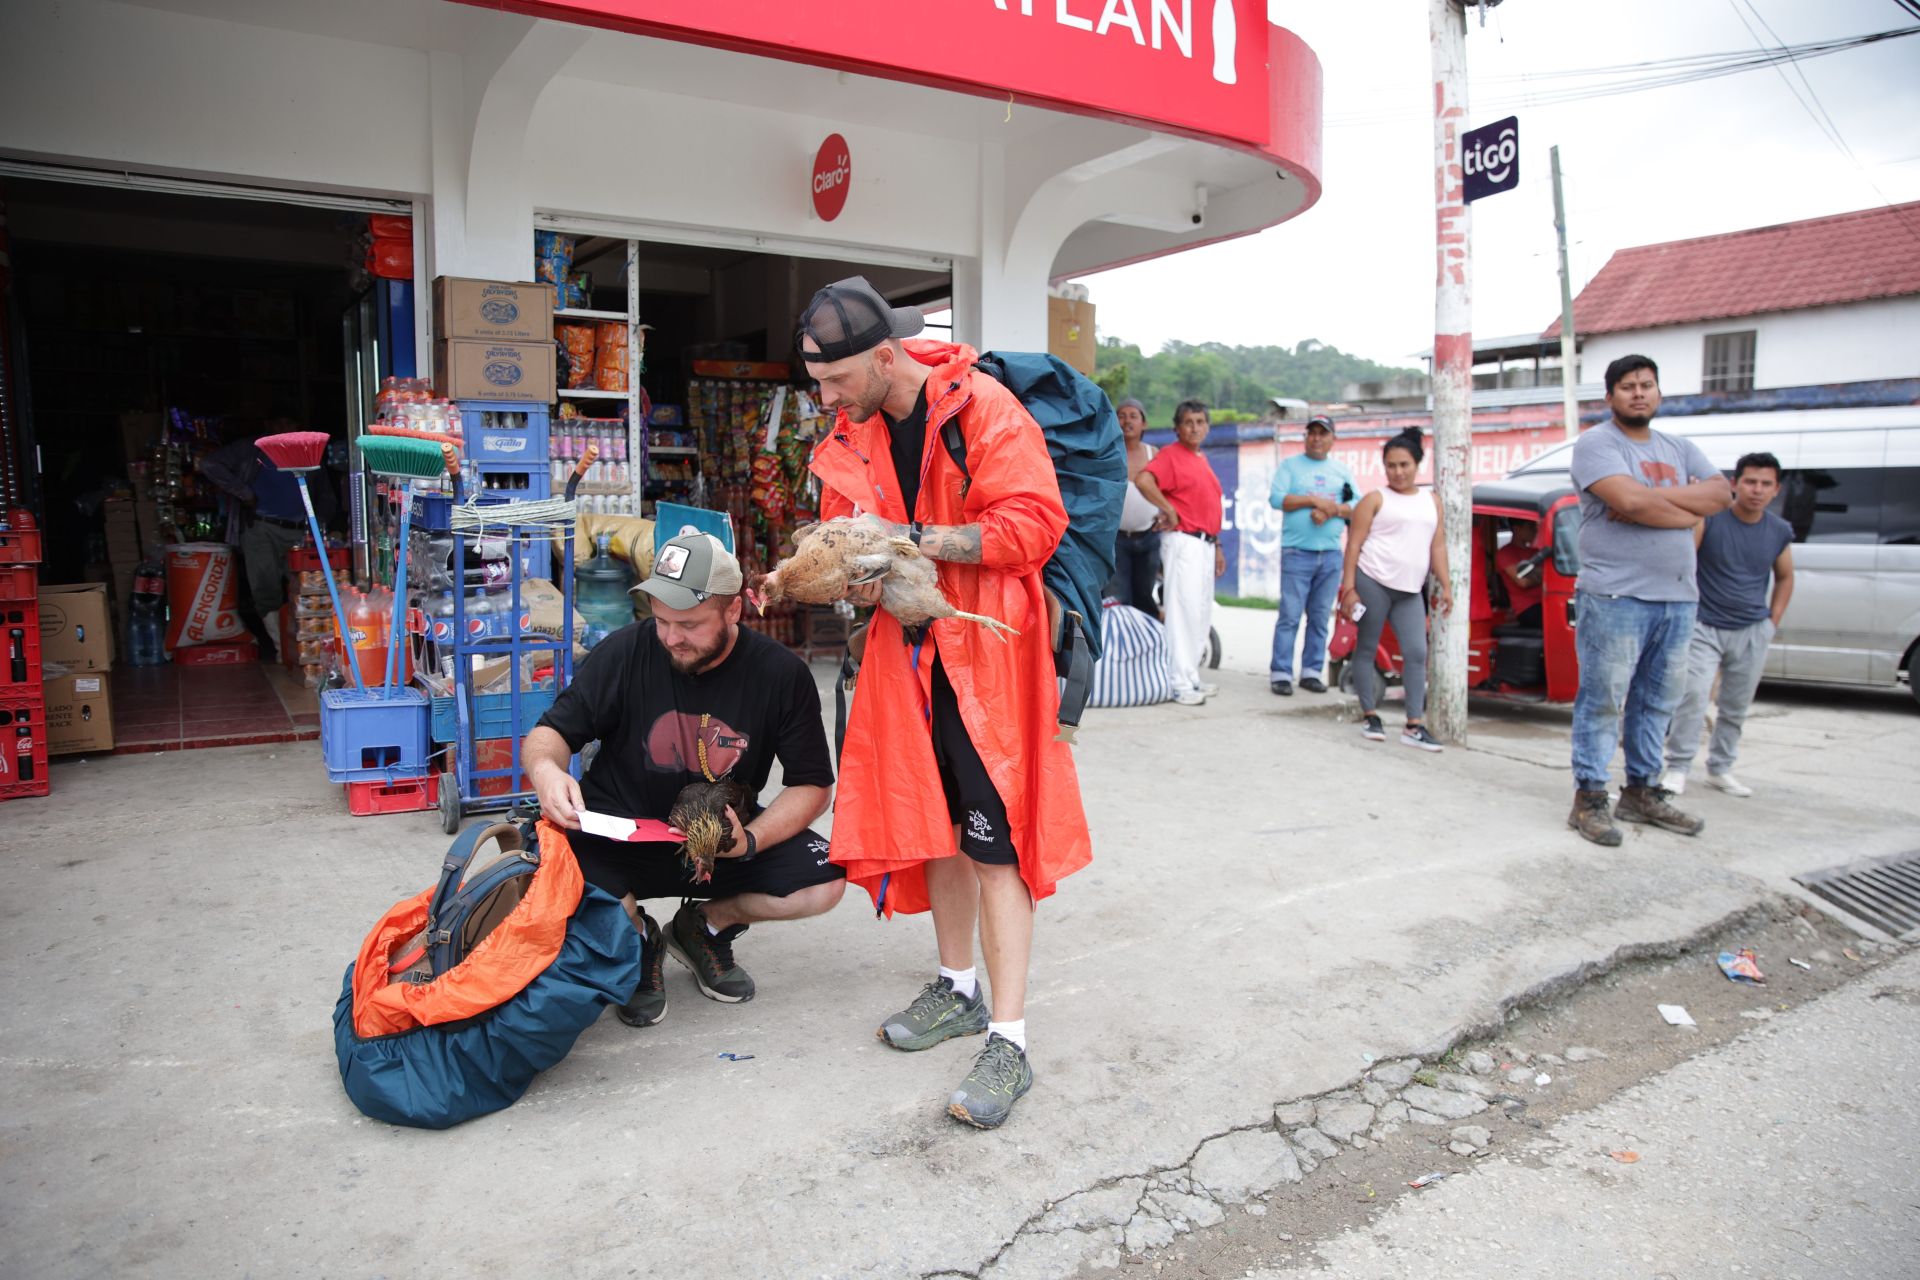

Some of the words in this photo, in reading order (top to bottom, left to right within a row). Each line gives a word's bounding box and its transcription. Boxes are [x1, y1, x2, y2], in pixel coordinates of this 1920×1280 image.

[995, 0, 1192, 58] LAN
[814, 166, 845, 194] Claro
[187, 555, 228, 641] ALIENGORDE
